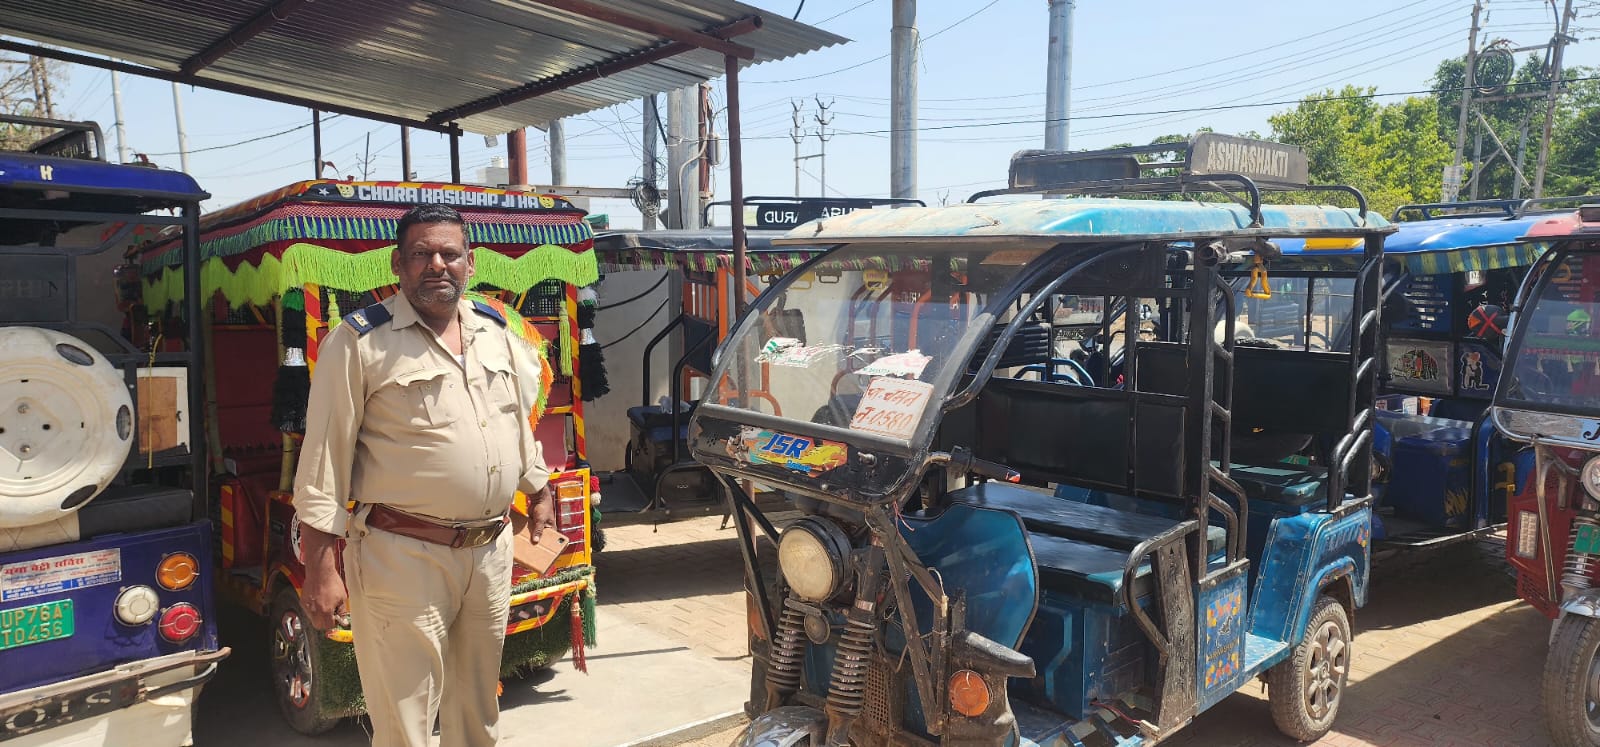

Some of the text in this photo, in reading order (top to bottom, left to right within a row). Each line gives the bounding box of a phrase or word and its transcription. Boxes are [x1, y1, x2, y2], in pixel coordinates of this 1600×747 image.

[1207, 141, 1289, 177] ASHVASHAKTI
[358, 185, 418, 202] CHORA
[421, 188, 498, 208] KASHYAP
[501, 194, 515, 208] JI
[761, 433, 810, 459] JSR
[2, 603, 63, 629] UP76A
